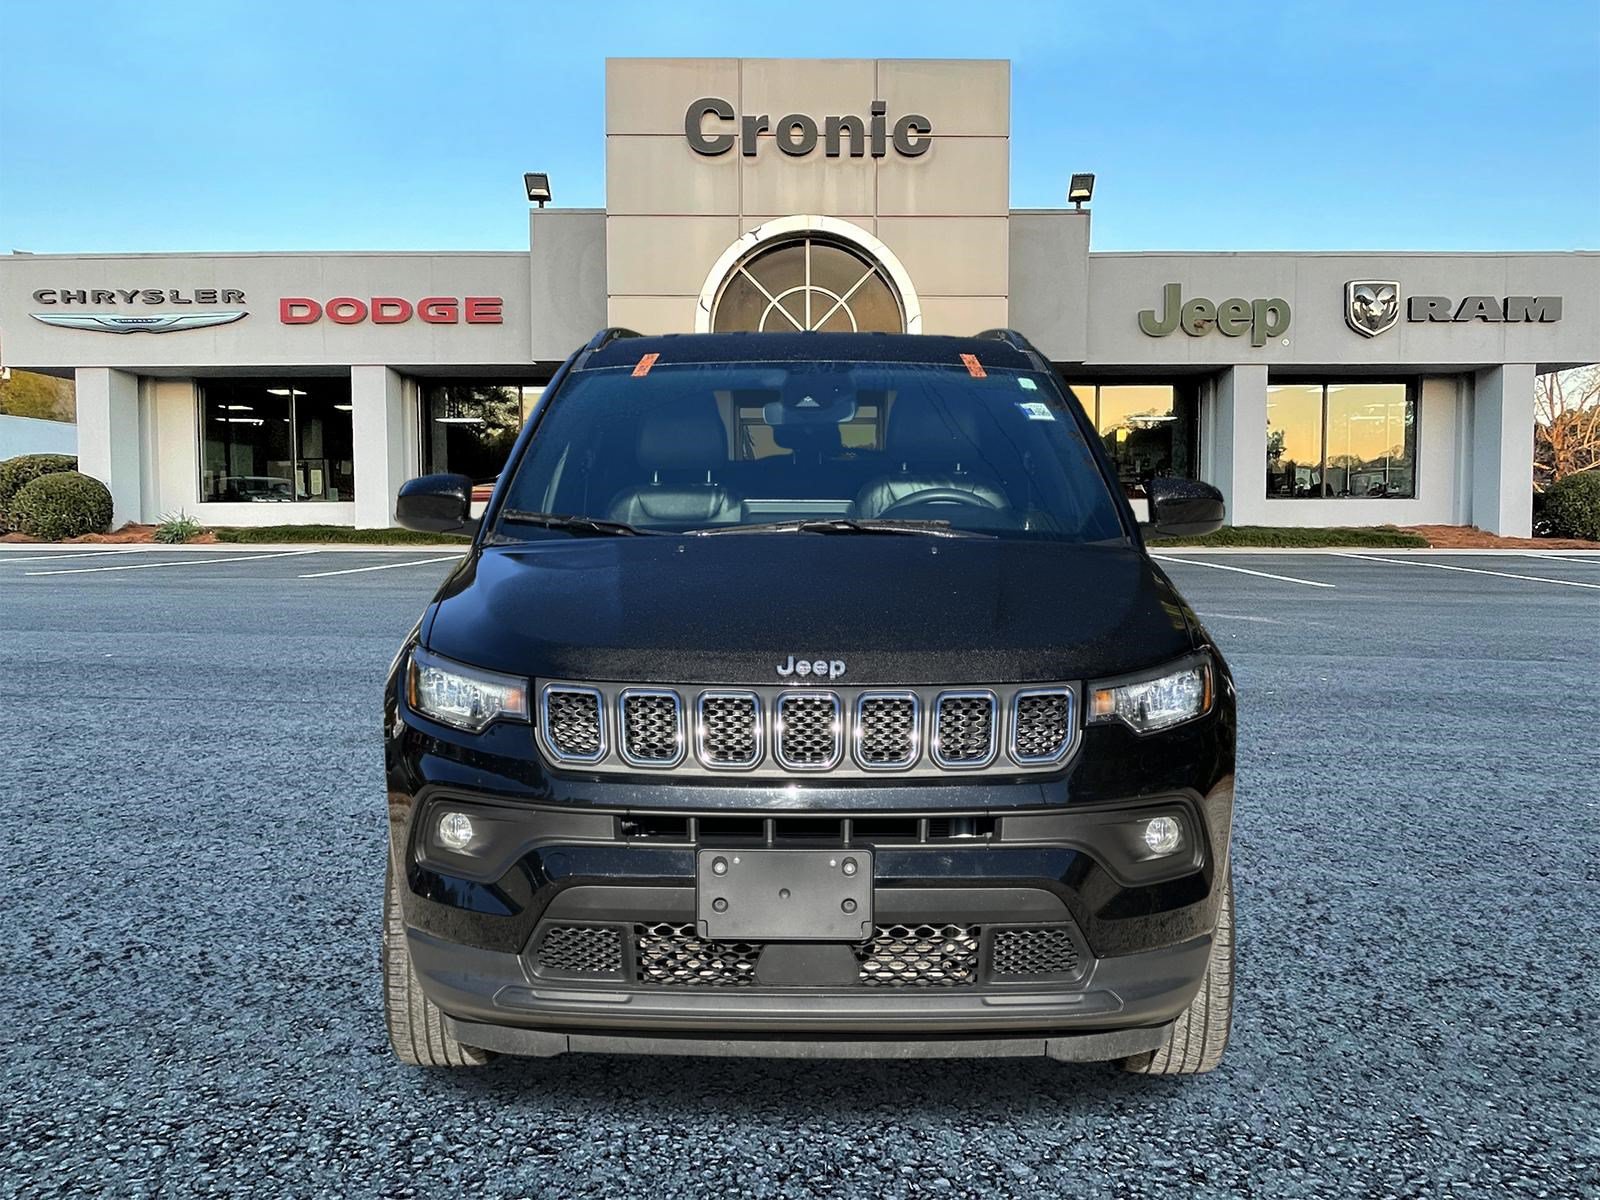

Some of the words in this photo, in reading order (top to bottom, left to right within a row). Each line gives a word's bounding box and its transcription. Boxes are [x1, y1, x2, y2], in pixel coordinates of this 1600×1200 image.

[685, 98, 932, 157] Cronic
[32, 289, 246, 305] CHRYSLER
[279, 296, 504, 325] DODGE
[1406, 296, 1563, 323] RAM
[1138, 283, 1292, 348] Jeep
[776, 655, 847, 681] Jeep
